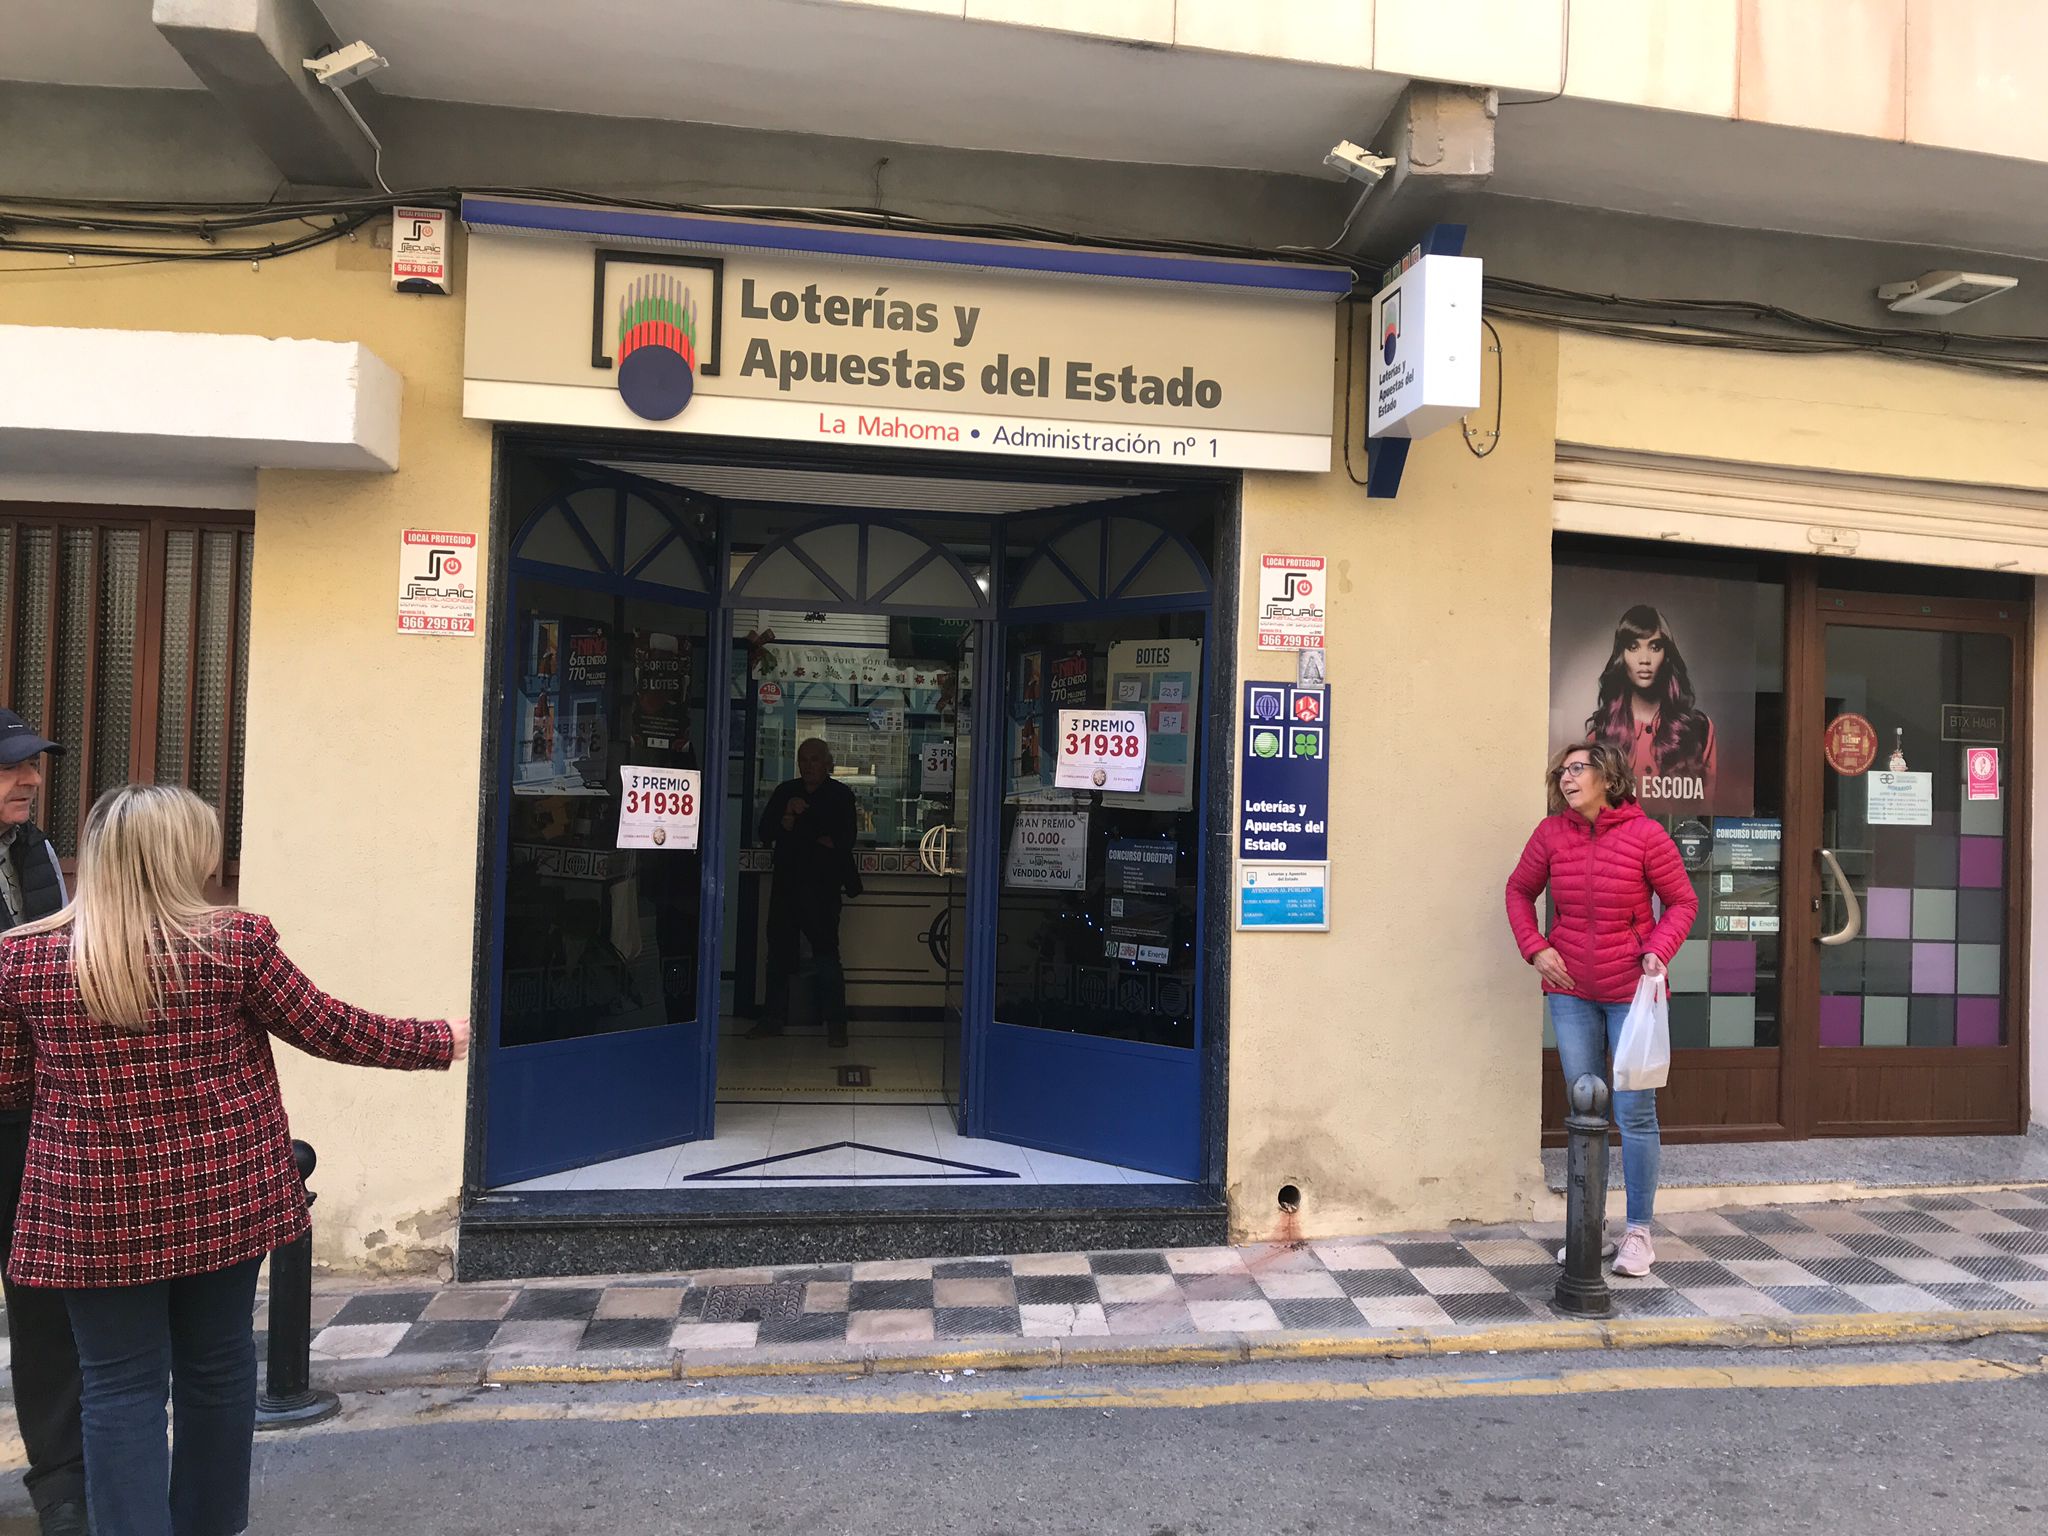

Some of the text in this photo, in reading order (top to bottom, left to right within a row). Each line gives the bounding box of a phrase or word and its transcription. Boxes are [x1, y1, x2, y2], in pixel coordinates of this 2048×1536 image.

[398, 264, 411, 272] 966
[427, 265, 439, 273] 612
[741, 279, 981, 347] Loterías y
[740, 338, 1222, 409] Apuestas del Estado
[1402, 360, 1407, 374] y
[1379, 368, 1414, 402] Apuestas del
[1378, 400, 1397, 418] Estado
[819, 413, 1217, 458] La Mahoma Administración nº 1
[408, 534, 471, 544] LOCAL PROTEGIDO
[1266, 557, 1320, 567] LOCAL PROTEGIDO
[402, 616, 470, 630] 966 299 612
[1262, 634, 1321, 647] 966 299 612
[570, 651, 607, 666] 6 DE ENERO
[1136, 647, 1170, 664] BOTES
[569, 667, 586, 680] 770
[644, 661, 679, 672] SORTEO
[642, 679, 680, 690] 3 LOTES
[1051, 674, 1087, 689] 6 DE ENERO
[1051, 688, 1067, 702] 770
[1082, 719, 1135, 733] PREMIO
[1973, 716, 1996, 729] HAIR
[1065, 733, 1139, 758] 31938
[643, 776, 690, 791] PREMIO
[1642, 776, 1704, 799] ESCODA
[626, 790, 694, 816] 31938
[1245, 800, 1307, 816] Loterías y
[1042, 819, 1075, 828] PREMIO
[1245, 819, 1324, 834] Apuestas del
[1021, 832, 1060, 845] 10.000
[1716, 829, 1781, 840] CONCURSO LOGOTIPO
[1244, 838, 1287, 851] Estado
[1109, 849, 1173, 864] CONCURSO LOGOTIPO
[1012, 868, 1071, 879] VENDIDO AQUÍ
